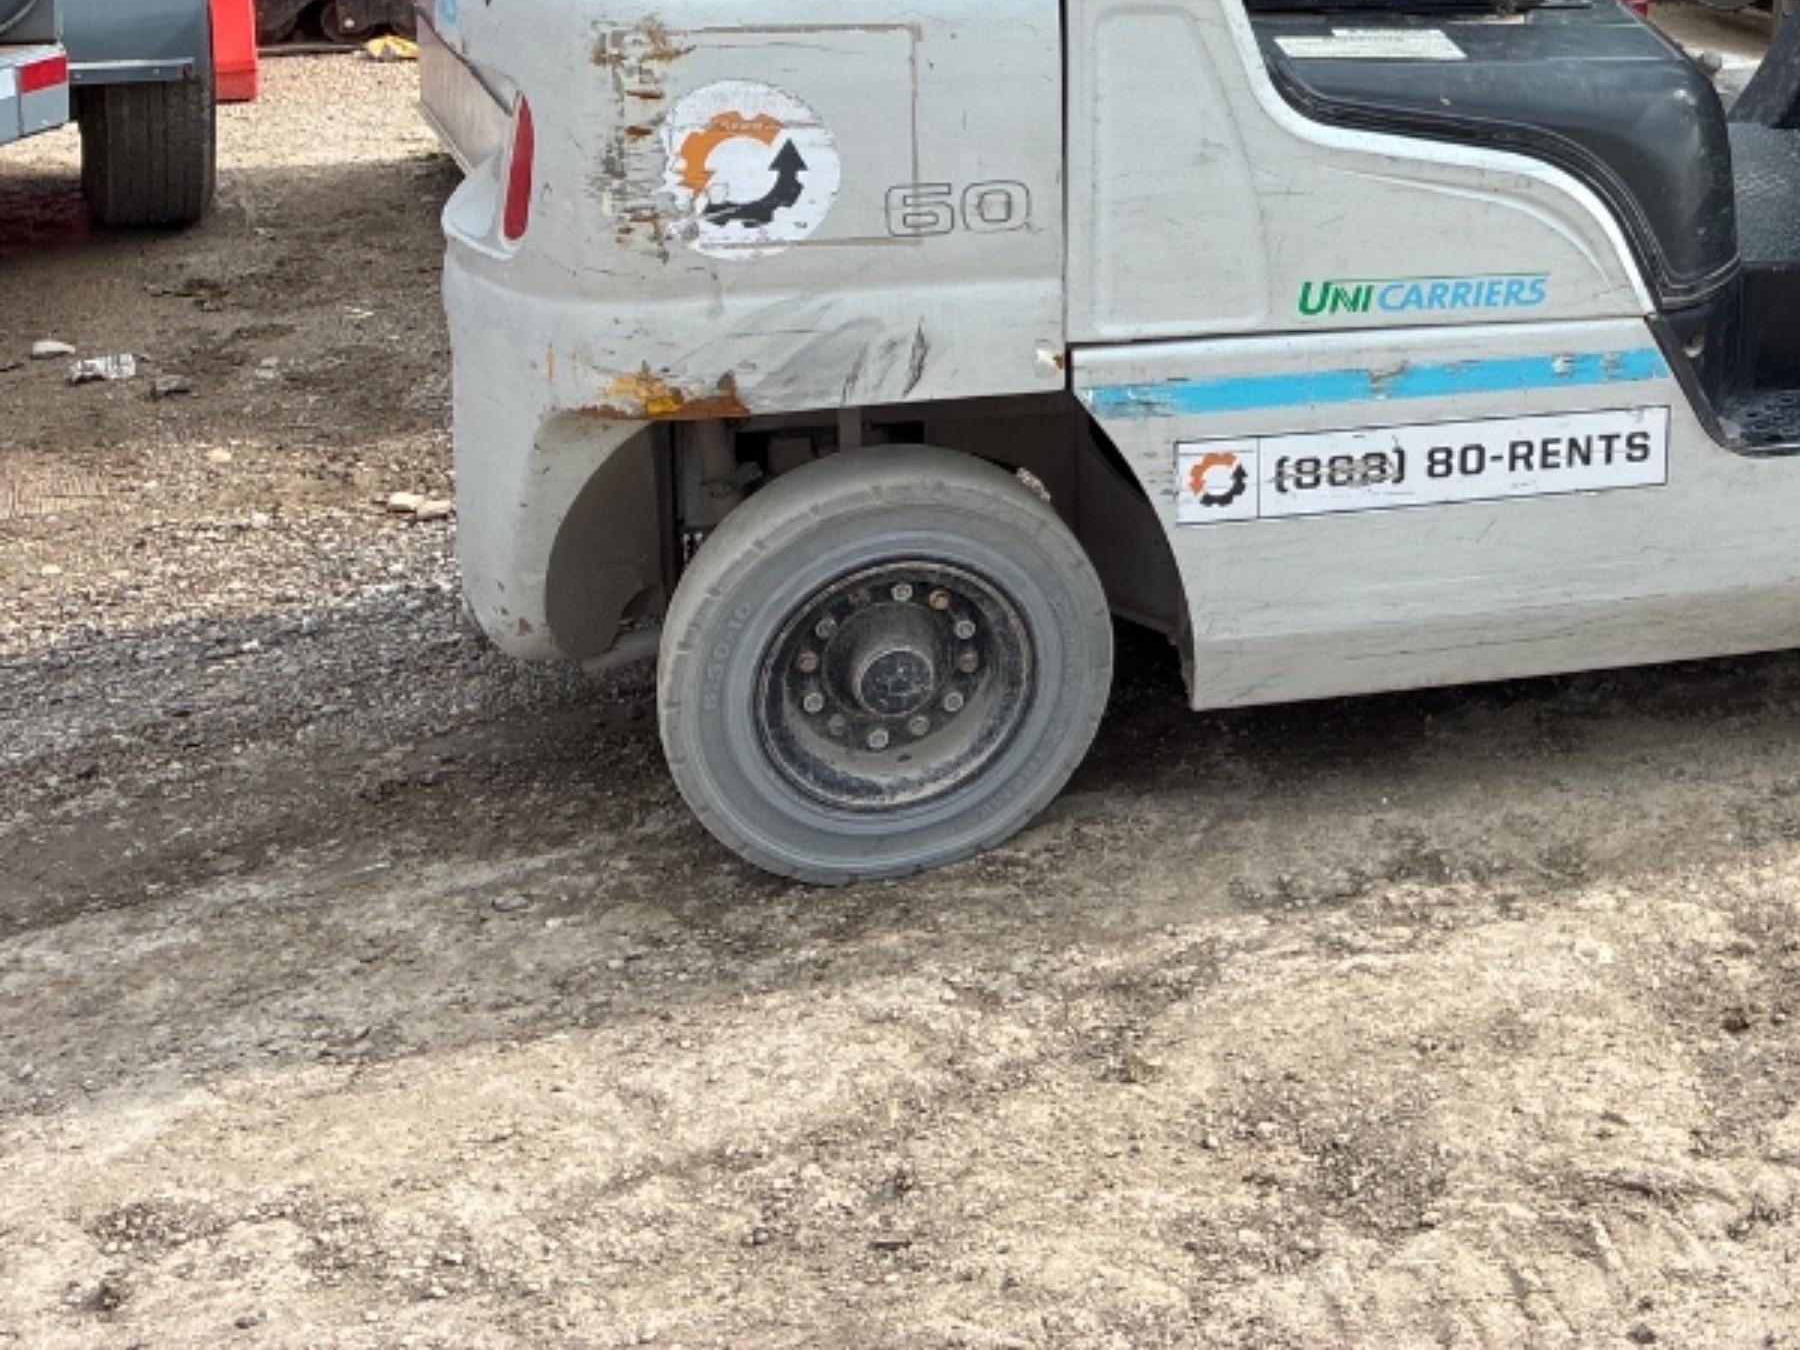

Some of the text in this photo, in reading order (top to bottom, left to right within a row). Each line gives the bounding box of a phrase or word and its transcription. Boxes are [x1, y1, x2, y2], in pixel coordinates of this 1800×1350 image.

[884, 179, 1032, 238] 60
[1297, 280, 1548, 316] UNICARRIERS
[1425, 430, 1652, 479] 80-RENTS
